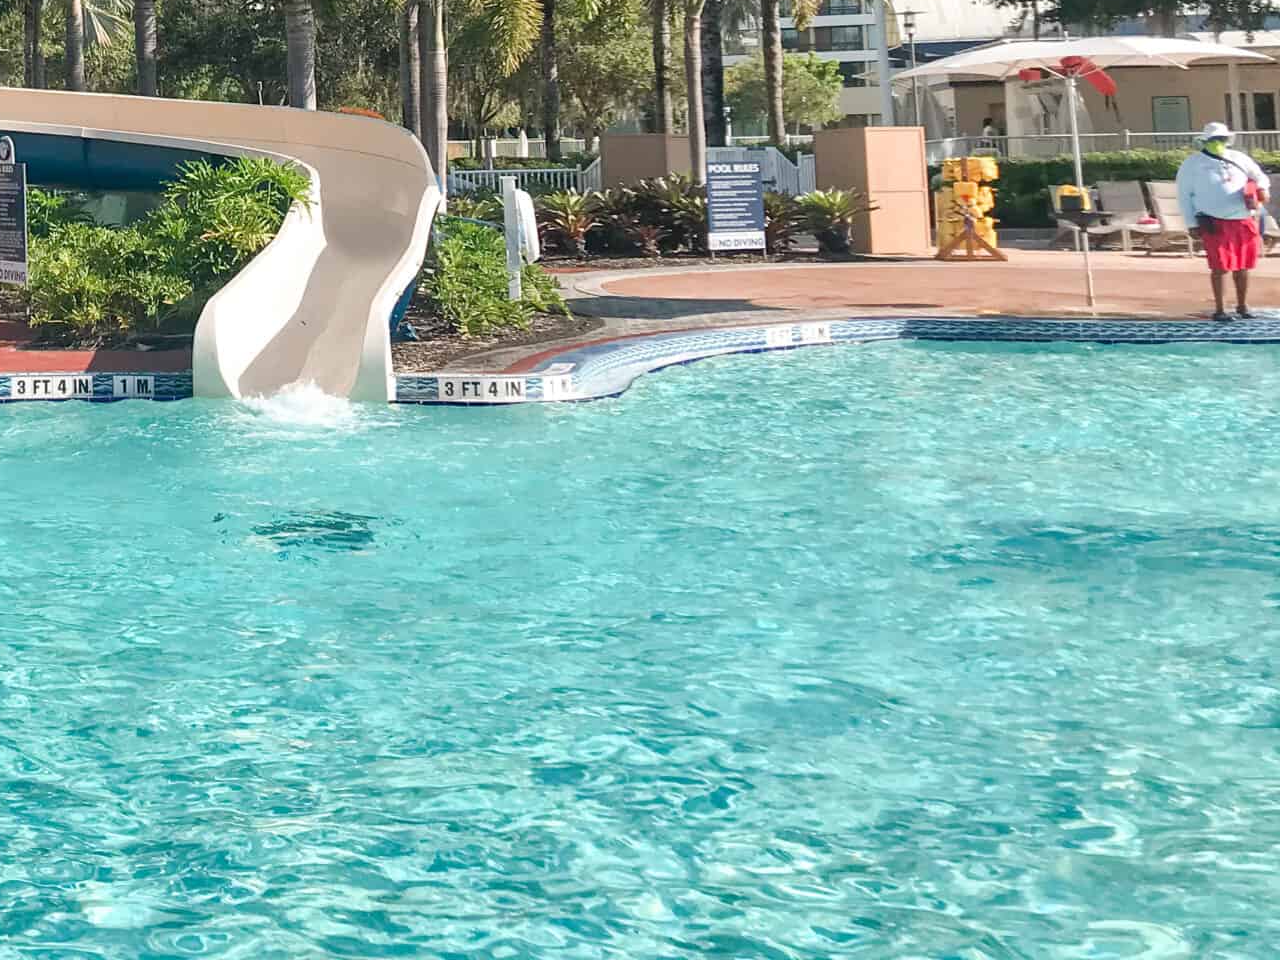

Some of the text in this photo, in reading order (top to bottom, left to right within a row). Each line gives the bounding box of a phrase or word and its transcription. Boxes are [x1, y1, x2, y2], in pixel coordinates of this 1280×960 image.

[708, 164, 732, 173] POOL
[719, 238, 764, 248] NO DIVING
[17, 379, 26, 394] 3
[57, 379, 67, 394] 4
[120, 379, 128, 394] 1
[444, 381, 454, 396] 3
[488, 381, 498, 397] 4
